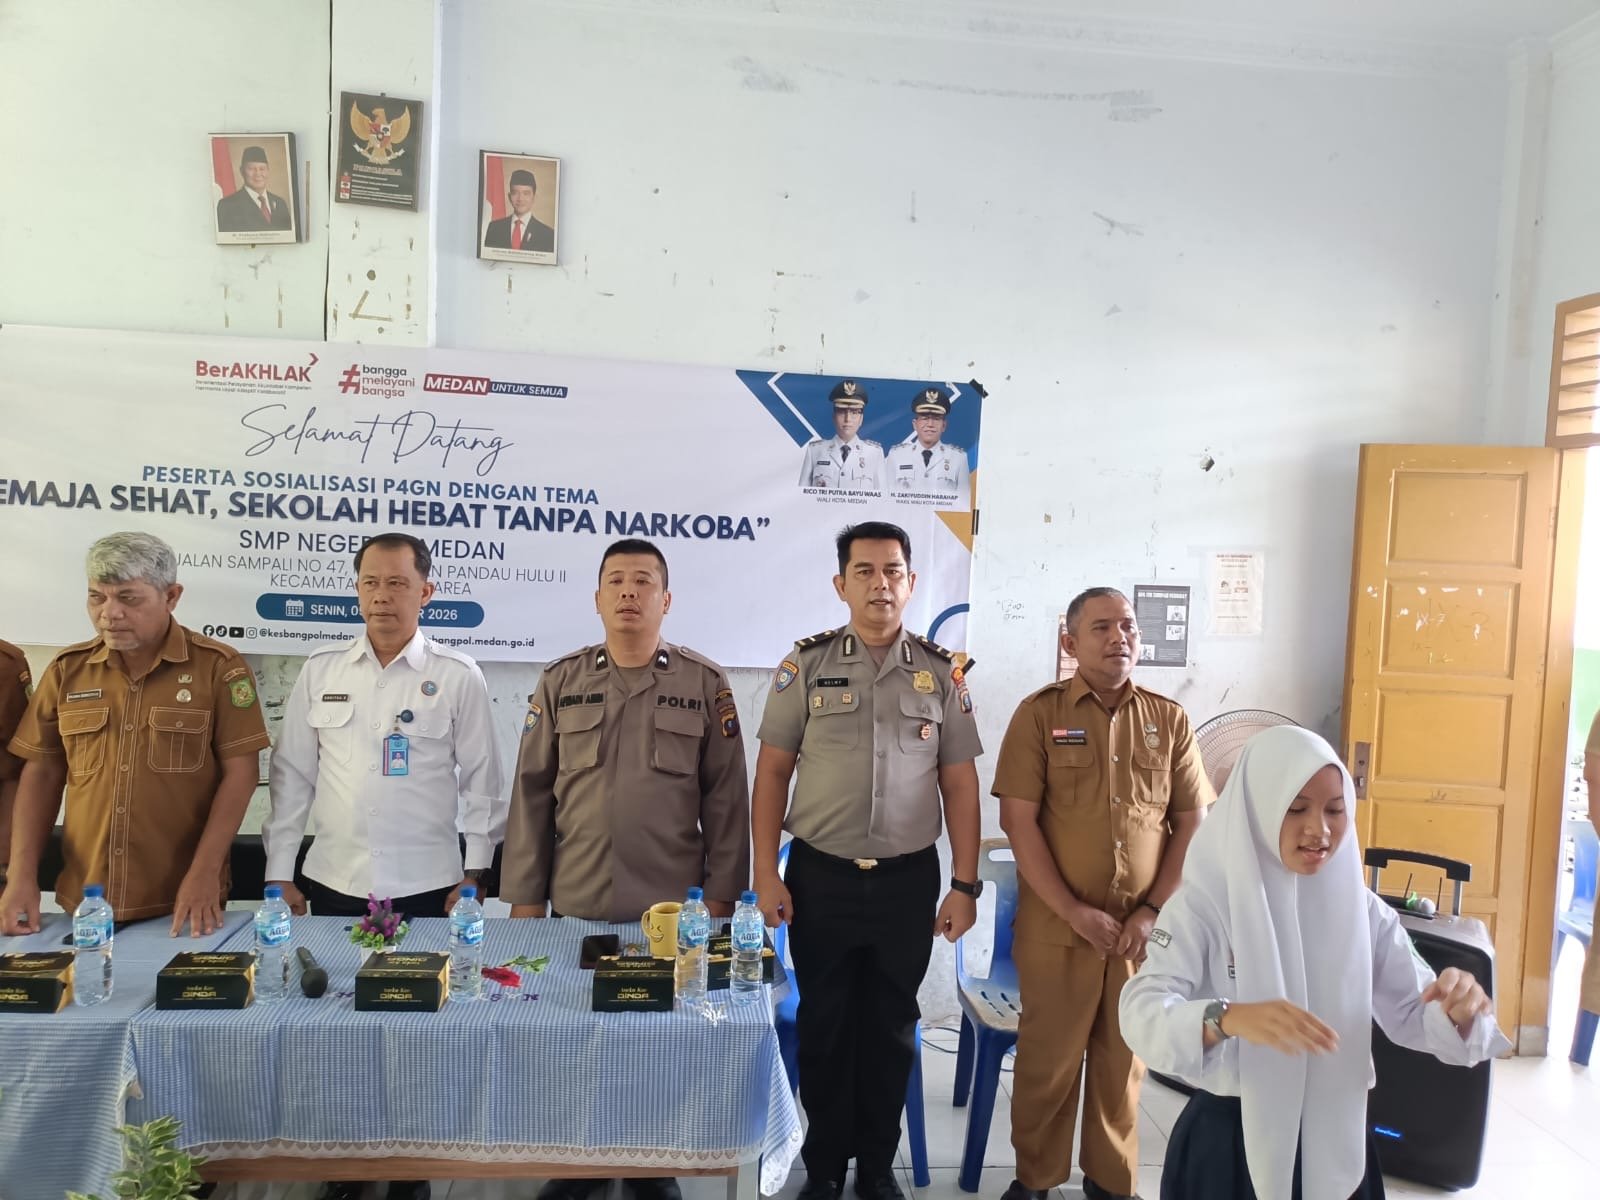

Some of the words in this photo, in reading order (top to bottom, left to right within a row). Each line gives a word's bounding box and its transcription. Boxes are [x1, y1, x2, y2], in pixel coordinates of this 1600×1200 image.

[196, 360, 312, 382] BerAKHLAK
[362, 364, 407, 377] bangga
[362, 376, 415, 388] melayani
[425, 376, 488, 393] MEDAN
[491, 383, 527, 394] UNTUK
[529, 386, 564, 397] SEMUA
[362, 387, 405, 399] bangsa
[241, 404, 413, 464] Selamat
[391, 410, 514, 476] Datang
[142, 465, 237, 487] PESERTA
[243, 470, 376, 494] SOSIALISASI
[383, 478, 441, 497] P4GN
[449, 482, 537, 502] DENGAN
[544, 487, 600, 505] TEMA
[110, 485, 218, 519] SEHAT,
[228, 492, 378, 523] SEKOLAH
[387, 500, 487, 530] HEBAT
[493, 505, 596, 534] TANPA
[239, 530, 290, 550] SMP
[177, 552, 222, 568] JALAN
[227, 556, 293, 571] SAMPALI
[298, 559, 322, 573] NO
[326, 560, 348, 576] 47,
[447, 566, 511, 581] PANDAU
[516, 569, 554, 582] HULU
[270, 574, 355, 590] KECAMATA
[434, 581, 471, 595] AREA
[310, 604, 348, 617] SENIN,
[428, 609, 458, 620] 2026
[429, 635, 535, 648] bangpol.medan.go.id
[657, 695, 701, 711] POLRI
